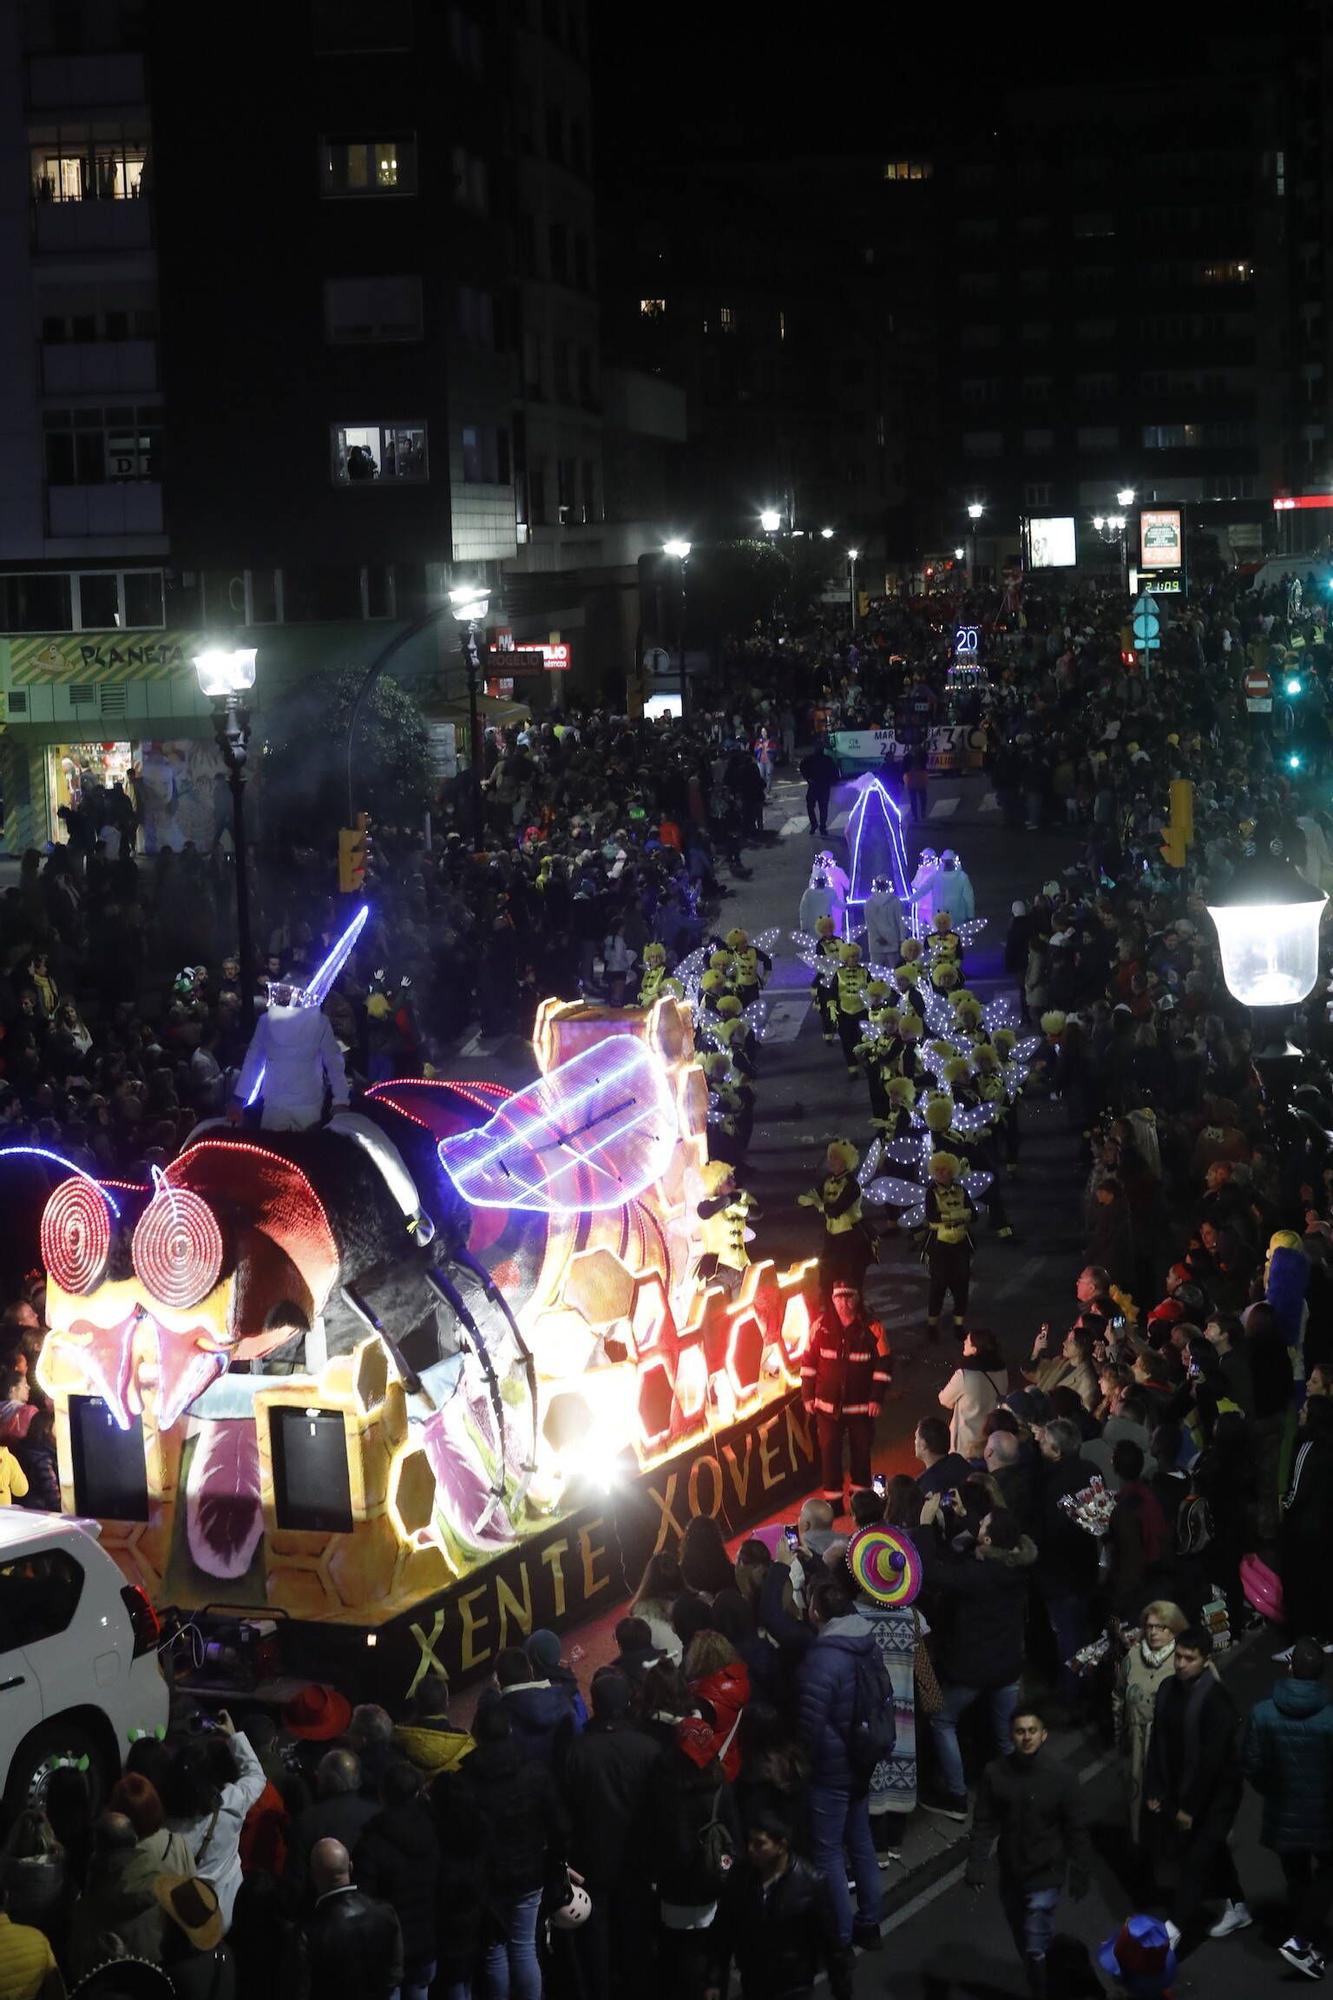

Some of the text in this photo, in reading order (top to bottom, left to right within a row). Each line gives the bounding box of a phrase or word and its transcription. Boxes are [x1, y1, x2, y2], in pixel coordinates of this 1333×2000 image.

[1145, 581, 1180, 592] 21:09
[956, 630, 978, 652] 20
[79, 645, 185, 669] PLANETA
[487, 653, 539, 667] ROGELIO
[405, 1404, 815, 1699] XENTE XOVEN
